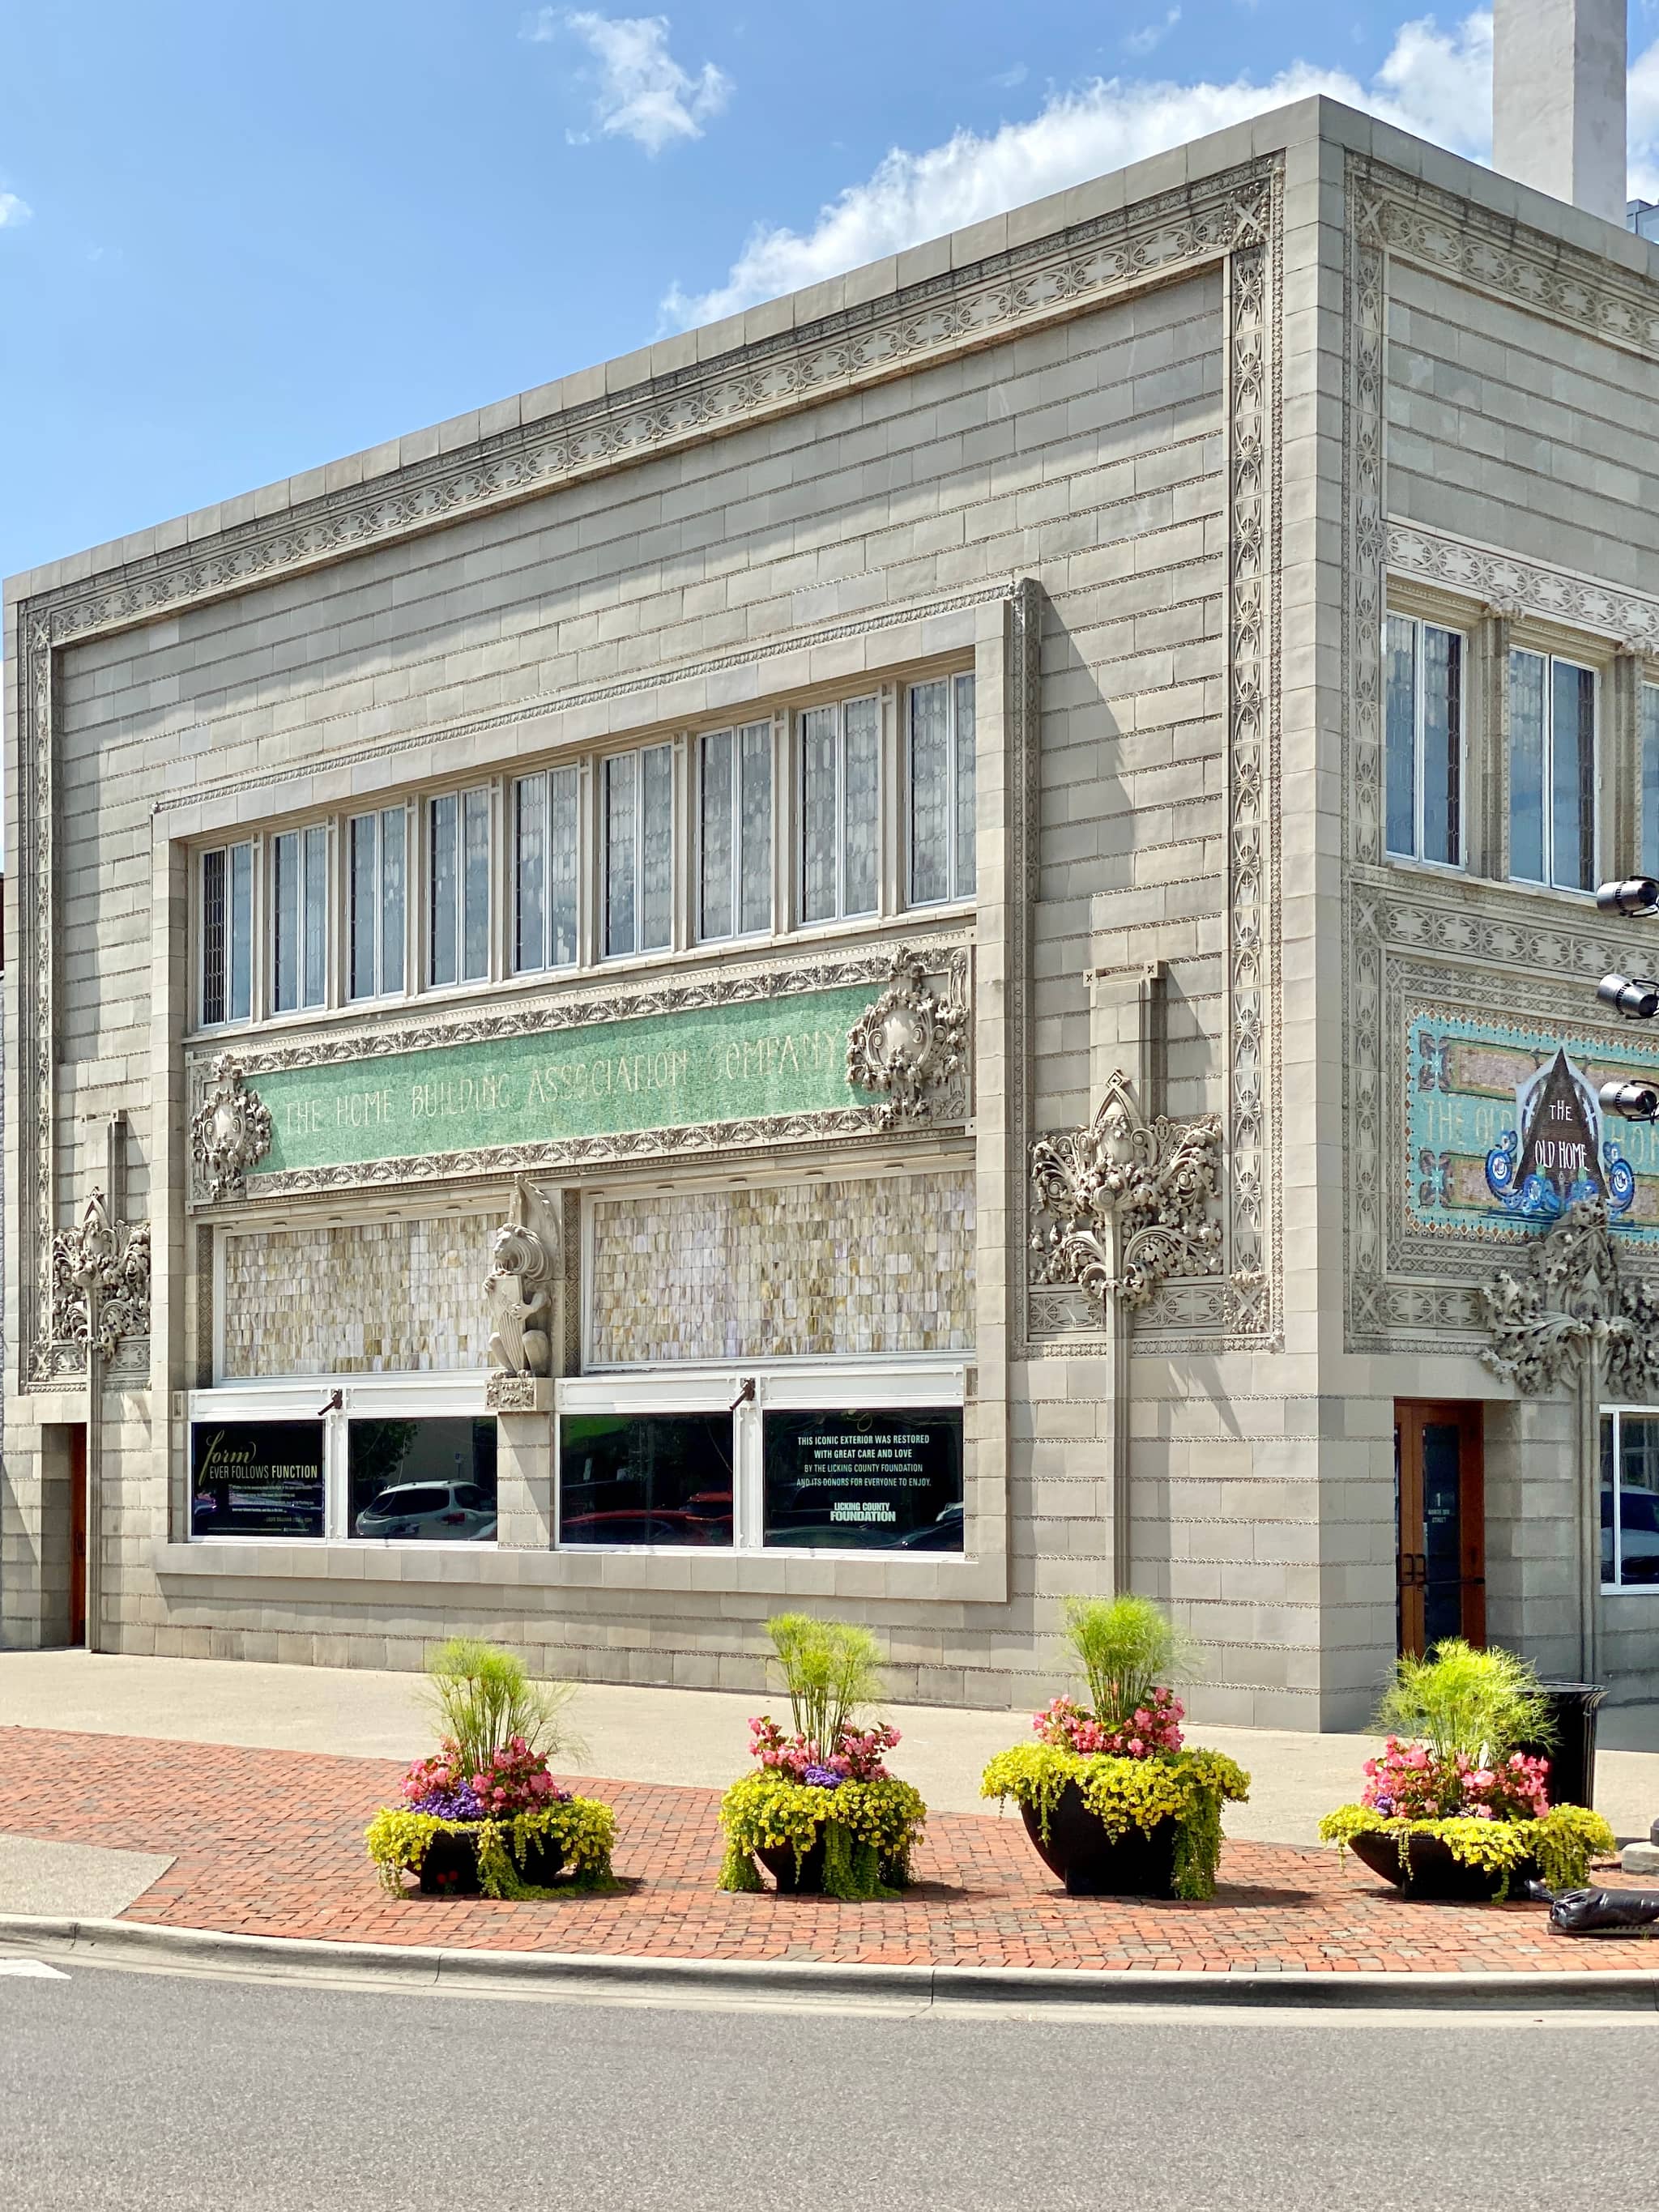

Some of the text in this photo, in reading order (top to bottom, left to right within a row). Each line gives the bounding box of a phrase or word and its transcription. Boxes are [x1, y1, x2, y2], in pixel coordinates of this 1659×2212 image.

[285, 1028, 842, 1135] THE HOME BUILDING ASSOCIATION COMPANY
[1549, 1100, 1573, 1121] THE
[1425, 1099, 1465, 1145] THE
[1534, 1140, 1590, 1171] OLD HOME
[798, 1434, 930, 1446] THIS ICONIC EXTERIOR WAS RESTORED
[198, 1429, 256, 1486] form
[814, 1449, 913, 1459] WITH GREAT CARE AND LOVE
[210, 1464, 318, 1479] EVER FOLLOWS FUNCTION
[804, 1464, 923, 1473] BY THE LICKING COUNTY FOUNDATION
[796, 1477, 932, 1487] AND ITS DONORS FOR EVERYONE TO ENJOY.
[834, 1502, 890, 1511] LICKING COUNTY
[830, 1511, 896, 1521] FOUNDATION
